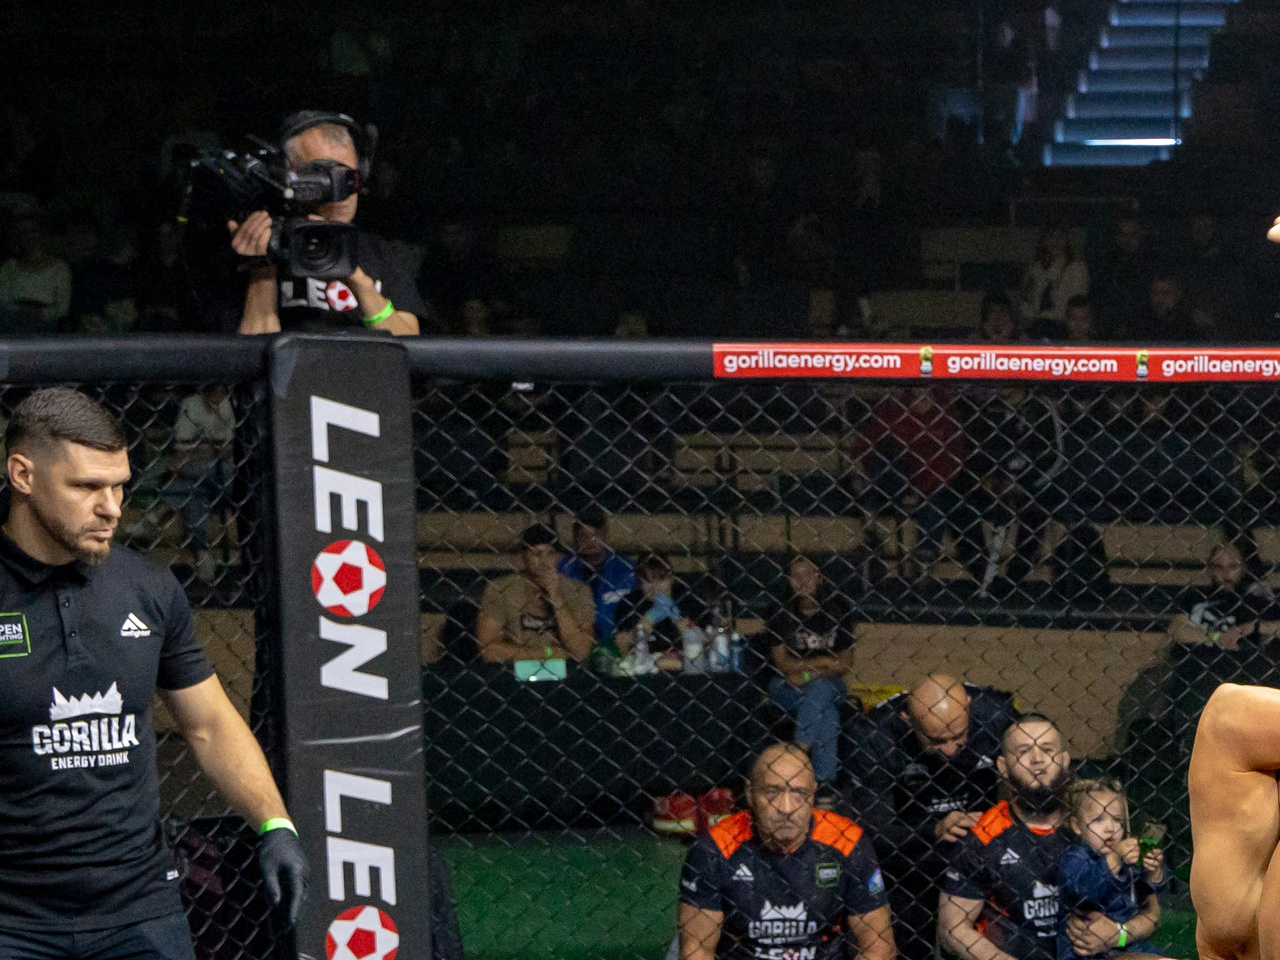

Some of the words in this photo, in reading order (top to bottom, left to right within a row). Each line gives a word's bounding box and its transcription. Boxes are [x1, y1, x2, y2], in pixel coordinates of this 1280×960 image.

[281, 277, 358, 313] LEO
[723, 352, 901, 373] gorillaenergy.com
[947, 354, 1118, 375] gorillaenergy.com
[311, 395, 389, 701] LEON
[32, 713, 140, 756] GORILLA
[51, 755, 97, 771] ENERGY
[97, 750, 130, 767] DRINK
